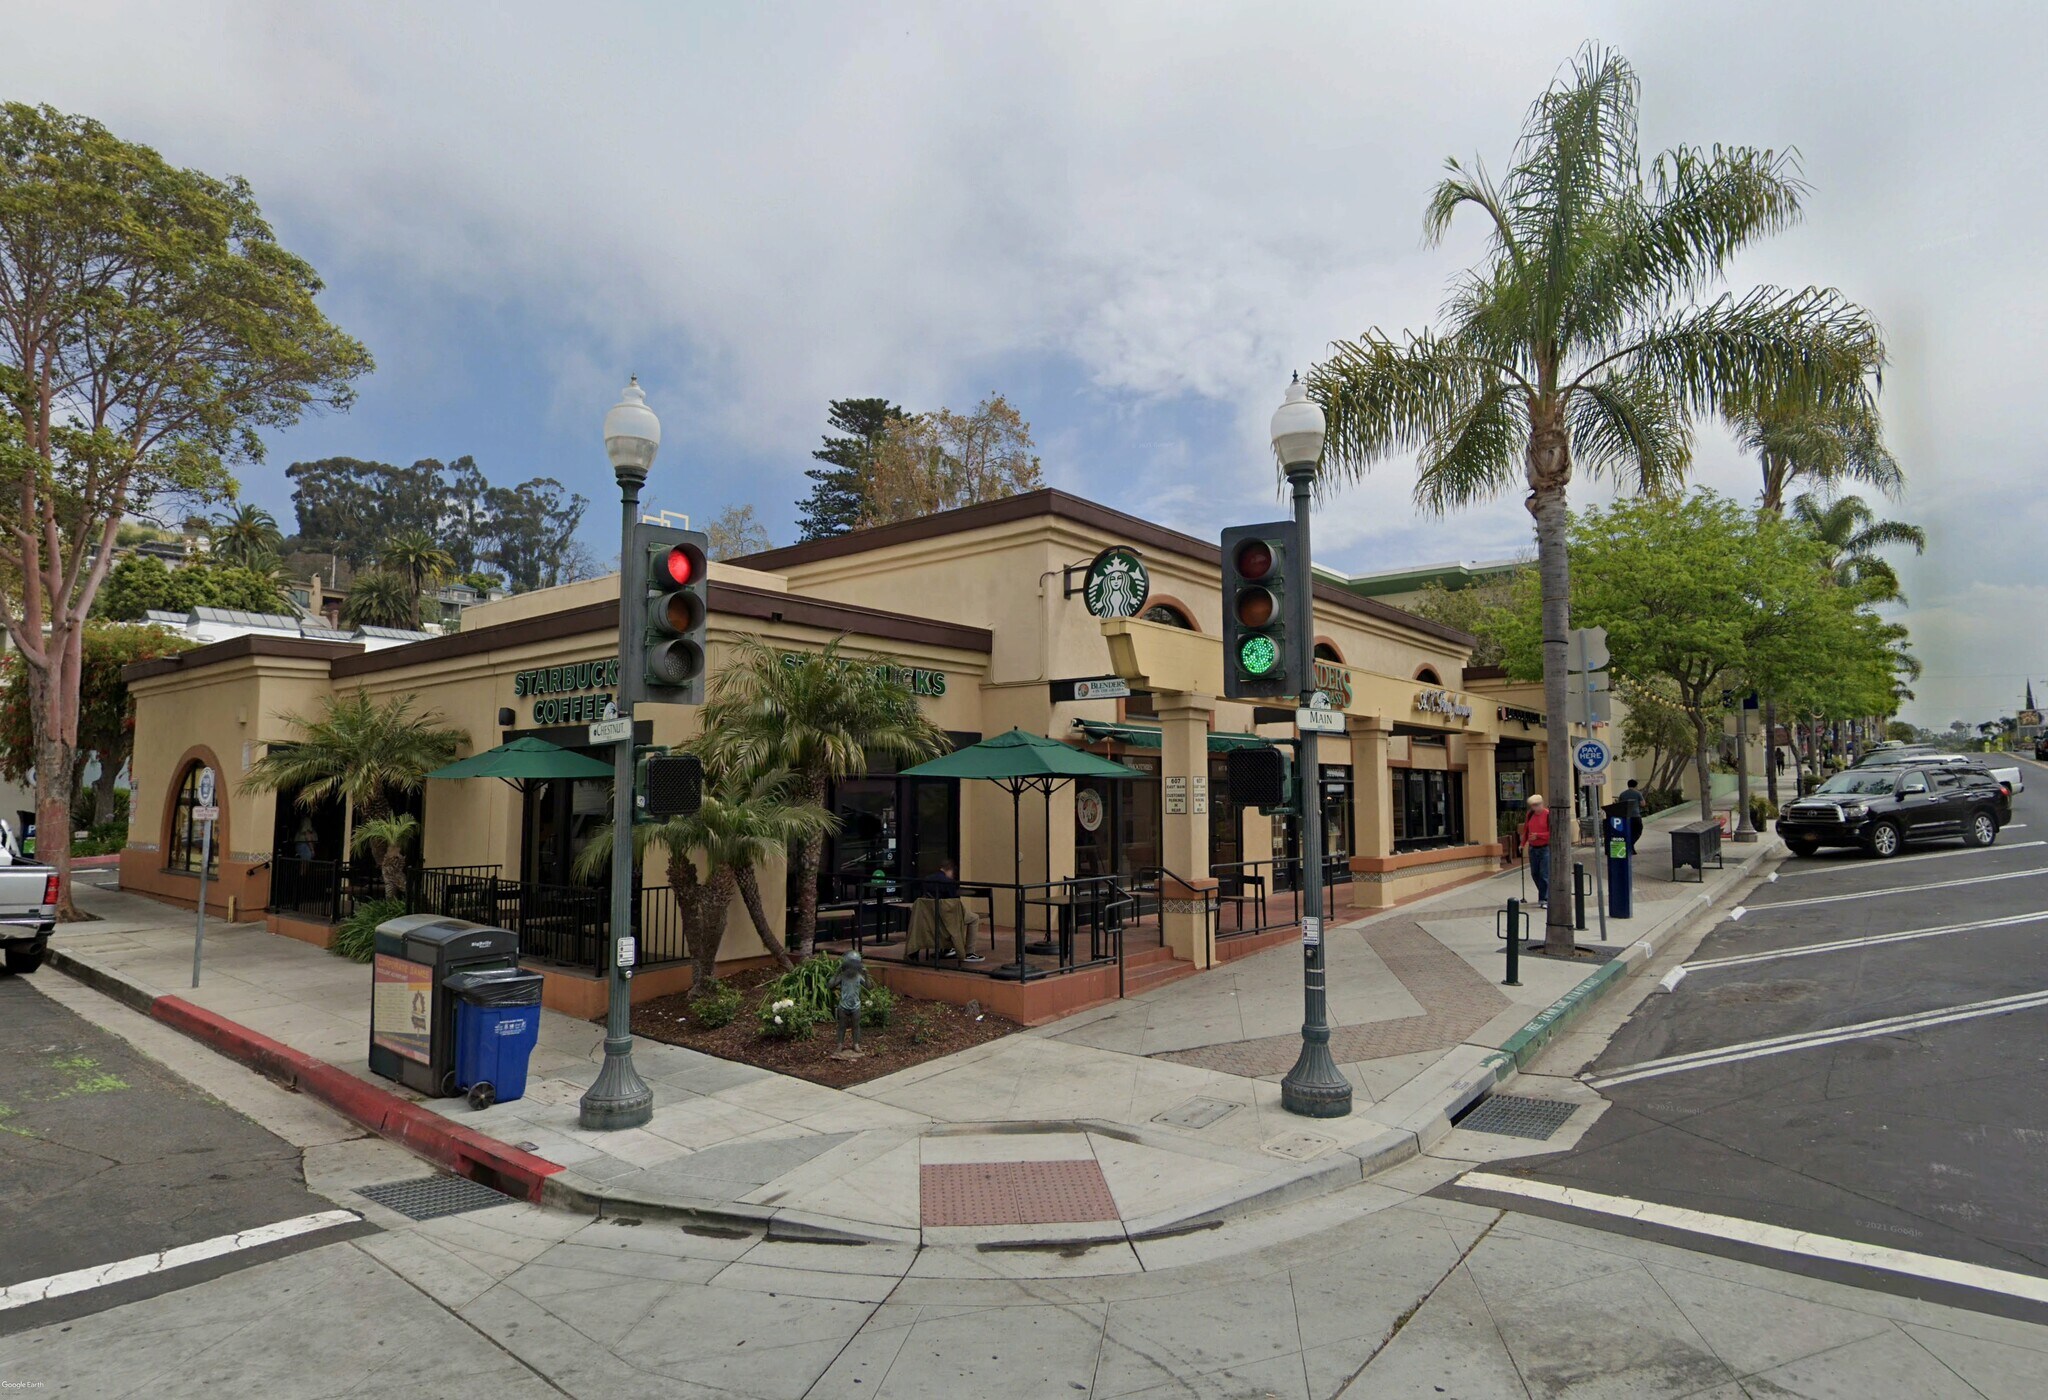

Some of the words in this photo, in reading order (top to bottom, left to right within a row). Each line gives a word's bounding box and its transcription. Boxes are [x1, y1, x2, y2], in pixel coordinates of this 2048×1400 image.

[515, 659, 619, 696] STARBUCK
[1091, 680, 1126, 690] BLENDERS
[533, 693, 608, 724] COFFEE
[1579, 752, 1602, 760] HERE
[1614, 818, 1621, 829] P
